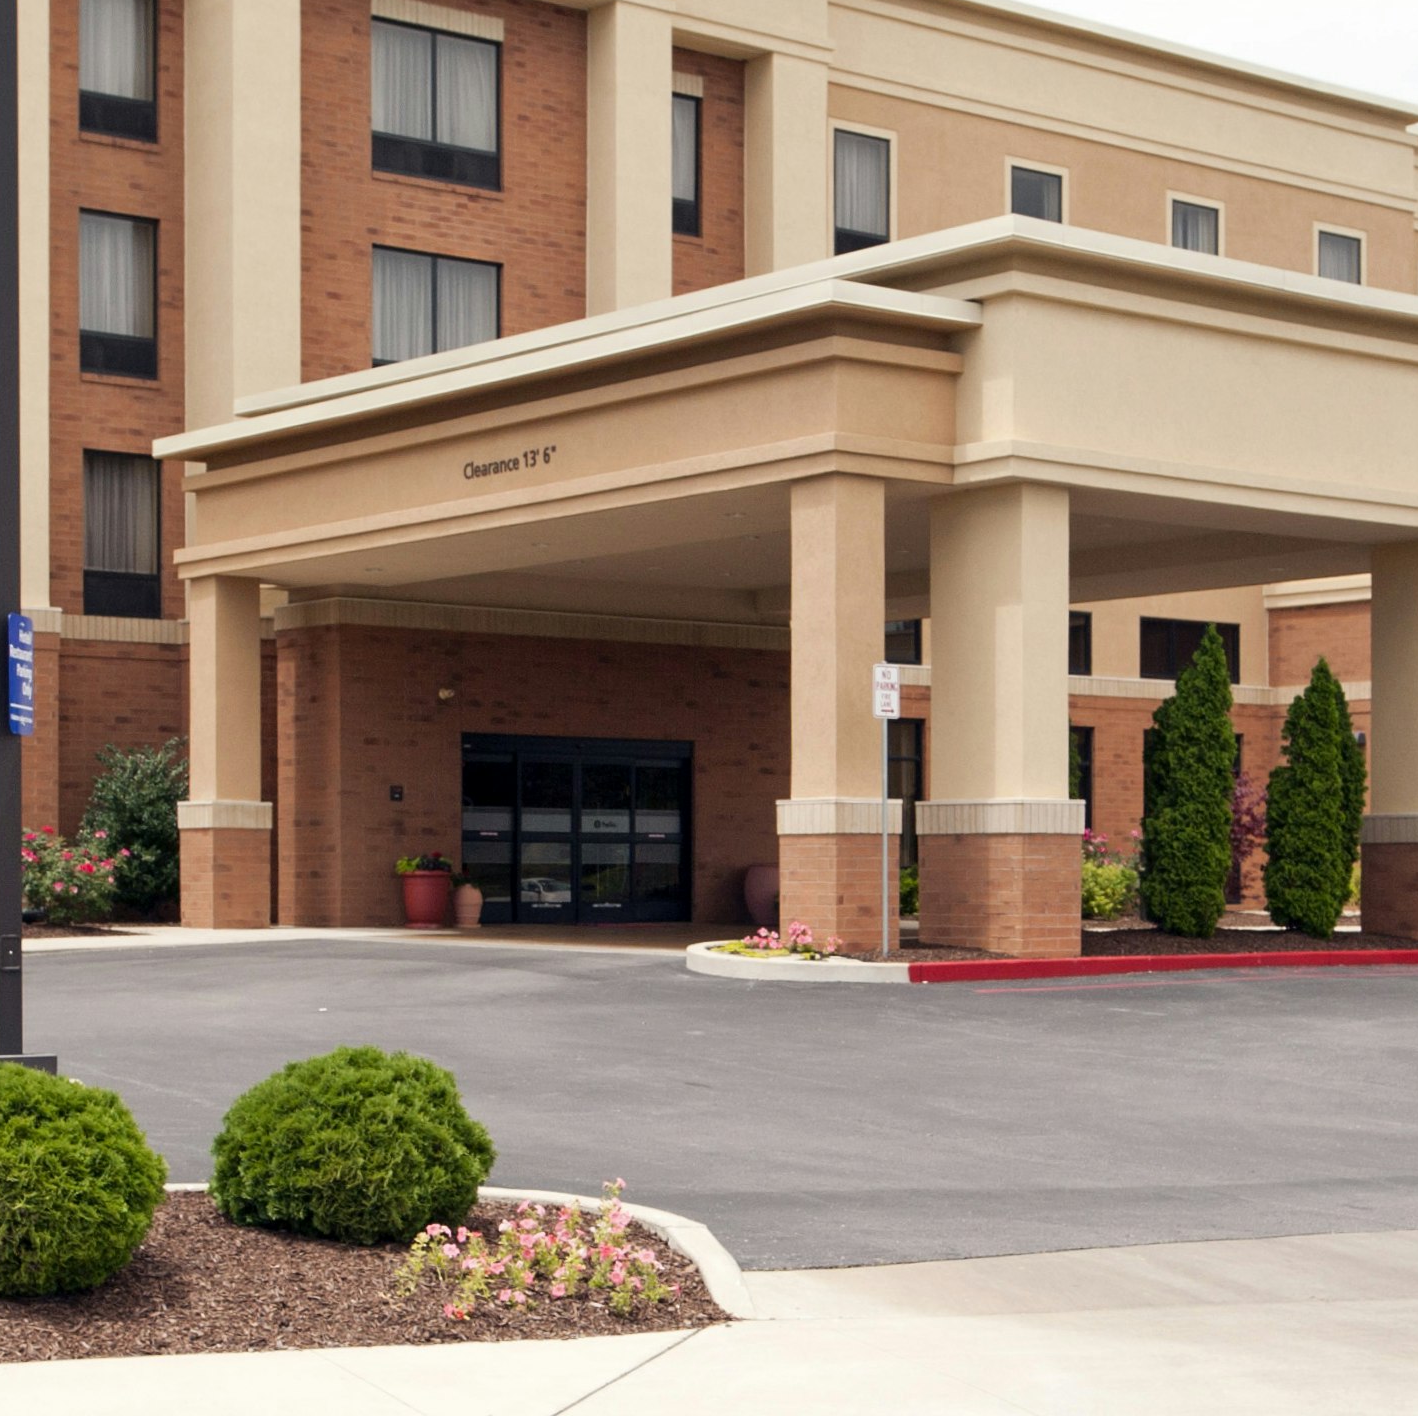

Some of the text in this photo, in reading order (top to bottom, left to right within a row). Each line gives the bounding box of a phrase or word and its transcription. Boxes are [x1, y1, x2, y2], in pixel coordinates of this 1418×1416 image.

[463, 445, 557, 480] Clearance 13' 6"
[882, 670, 892, 680] NO
